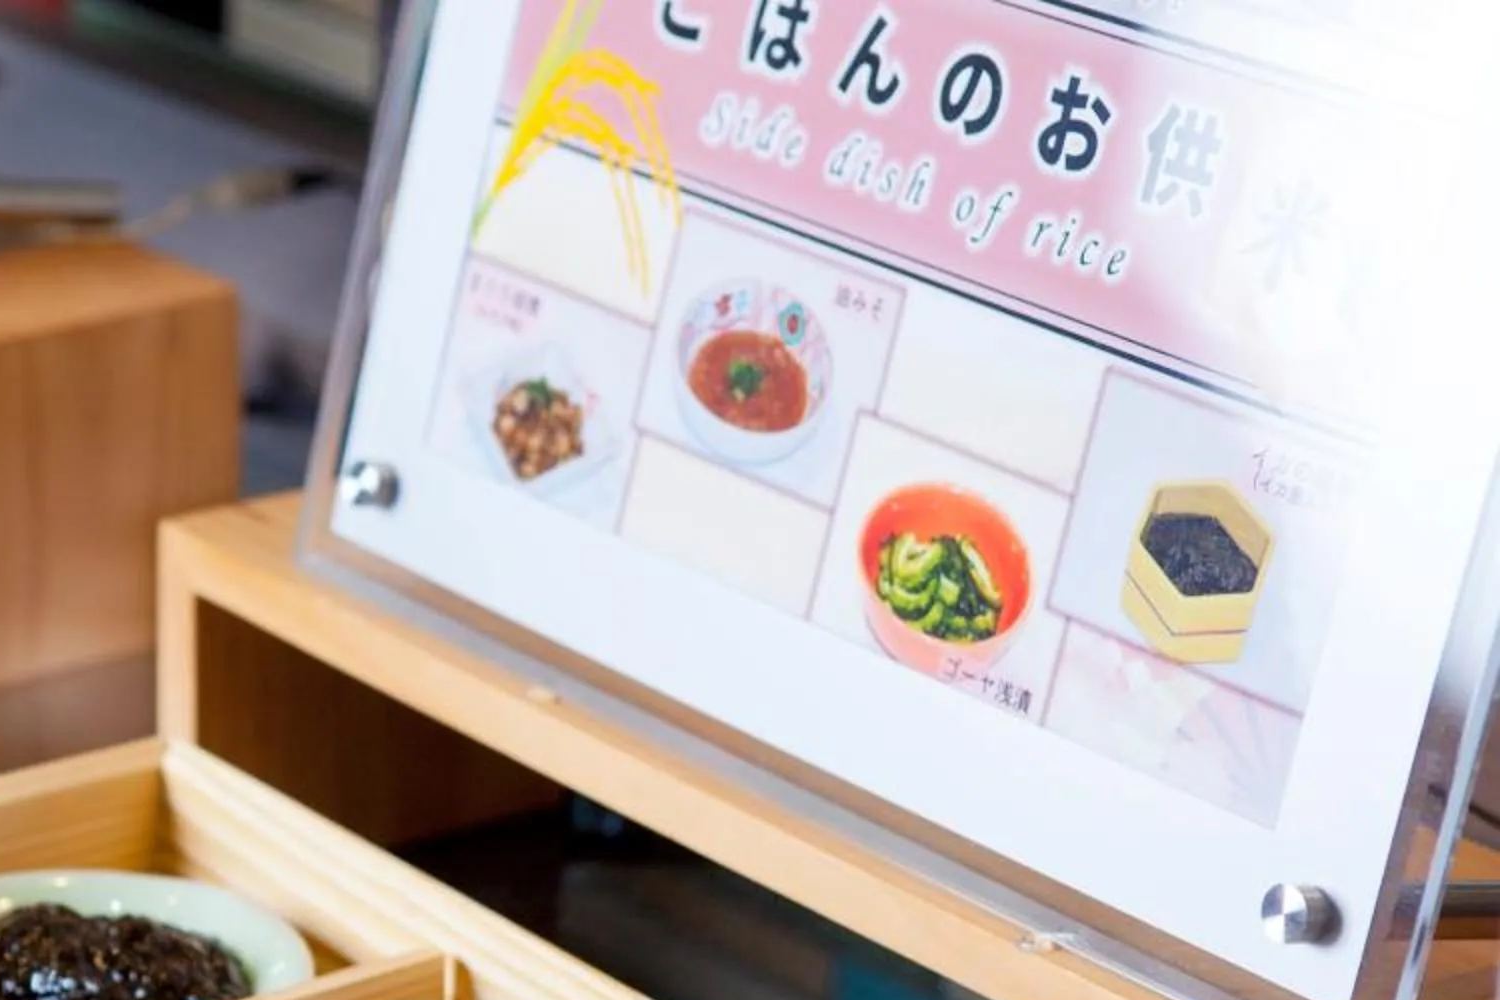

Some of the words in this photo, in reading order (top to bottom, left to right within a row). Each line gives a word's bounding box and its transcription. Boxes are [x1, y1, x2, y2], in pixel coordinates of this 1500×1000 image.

[703, 100, 805, 161] Side
[828, 137, 932, 207] dish
[955, 190, 1013, 243] of
[1032, 216, 1127, 276] rice
